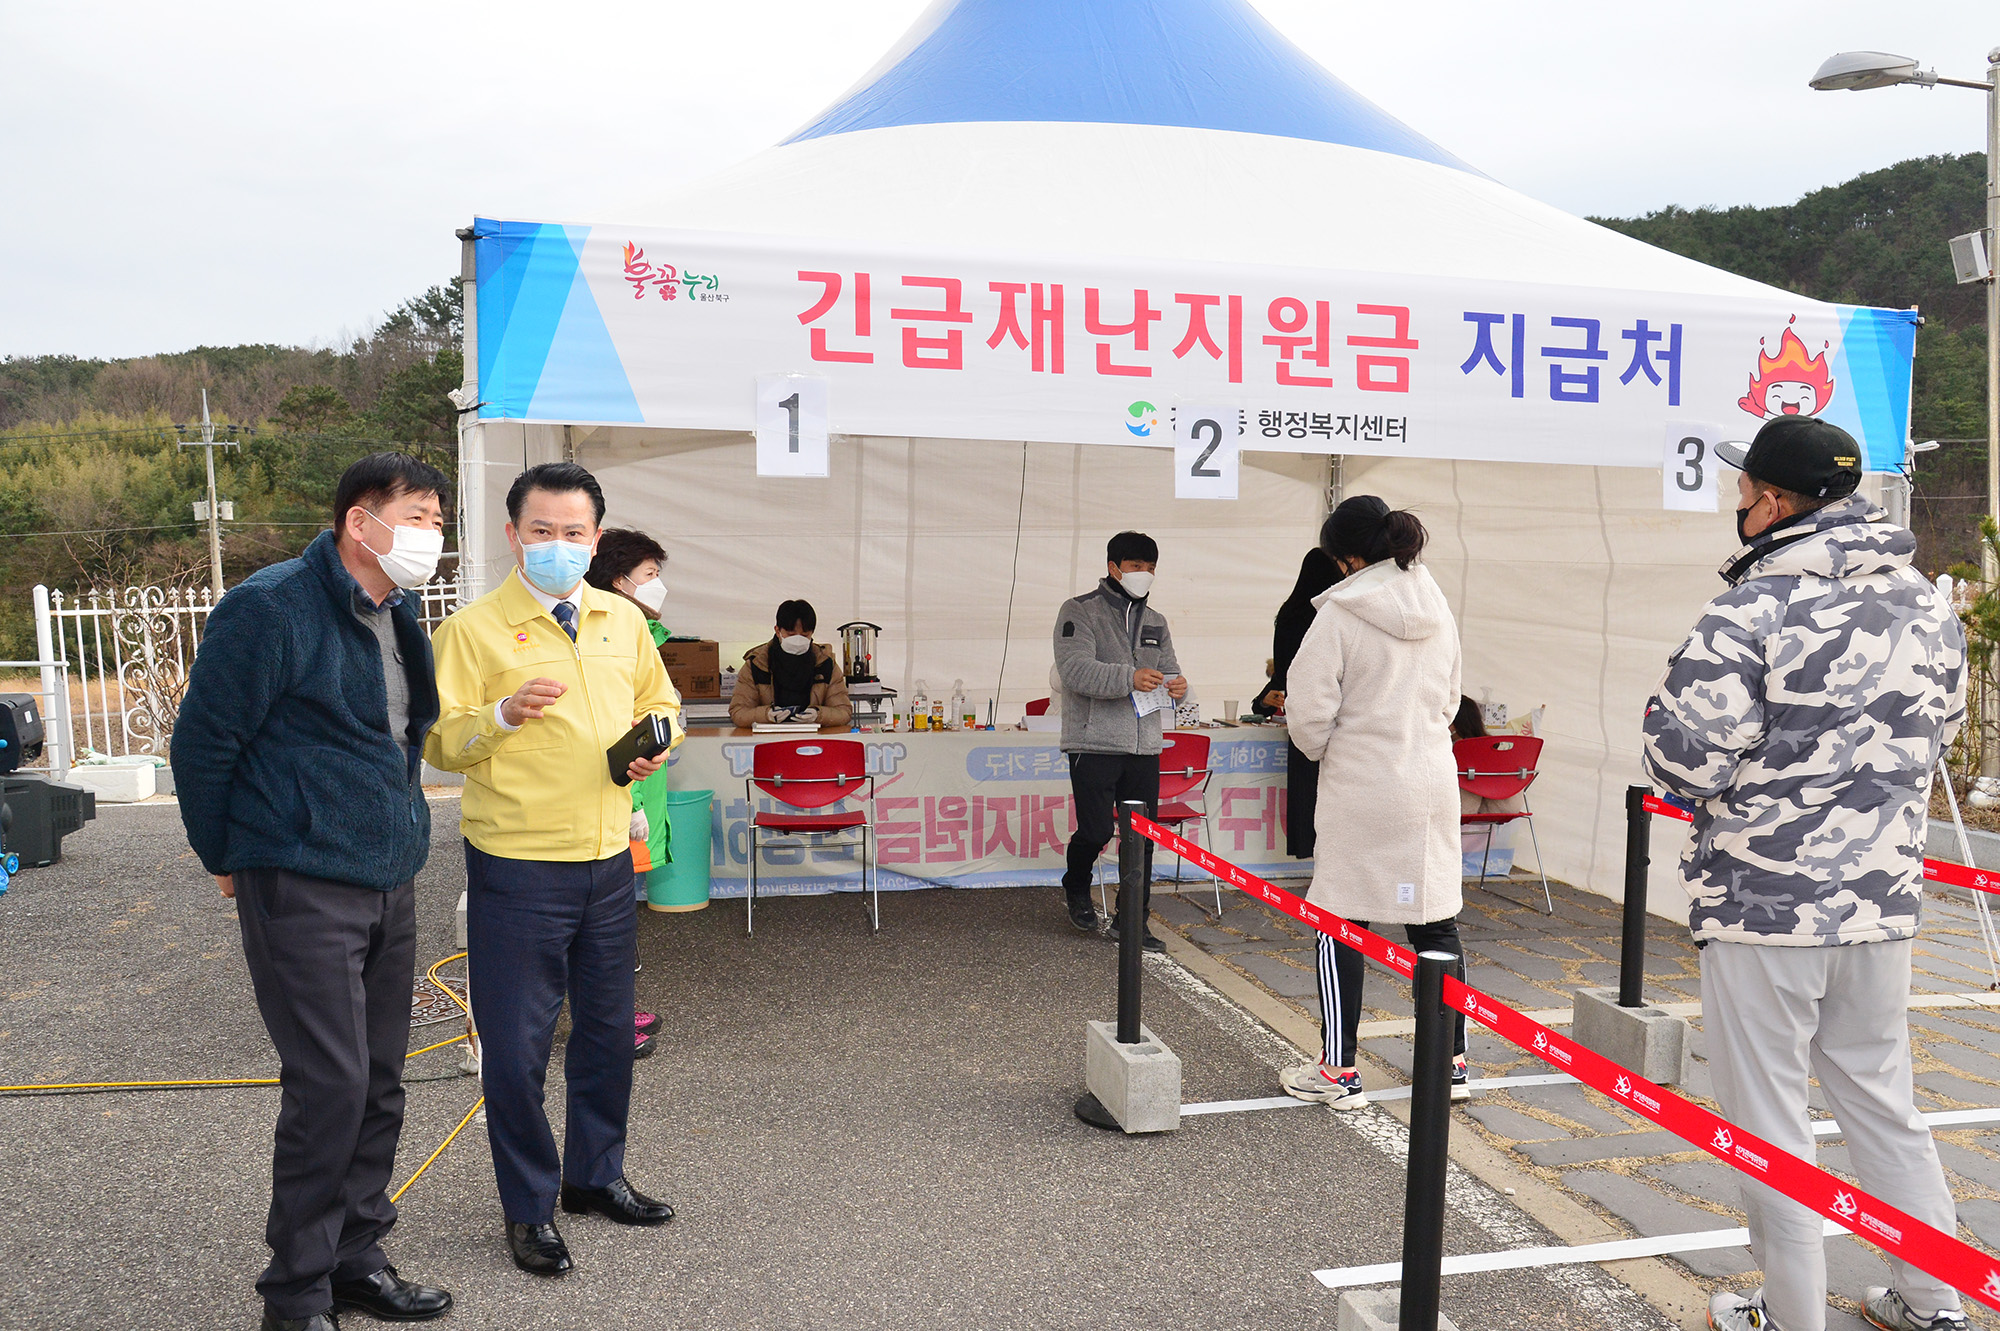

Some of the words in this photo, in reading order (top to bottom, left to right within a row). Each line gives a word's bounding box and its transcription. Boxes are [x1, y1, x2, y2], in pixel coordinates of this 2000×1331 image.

[796, 270, 1419, 393] 긴급재난지원금
[1459, 311, 1683, 406] 지급처
[778, 392, 800, 454] 1
[1190, 418, 1223, 478] 2
[1257, 409, 1408, 444] 행정복지센터
[1676, 436, 1706, 493] 3
